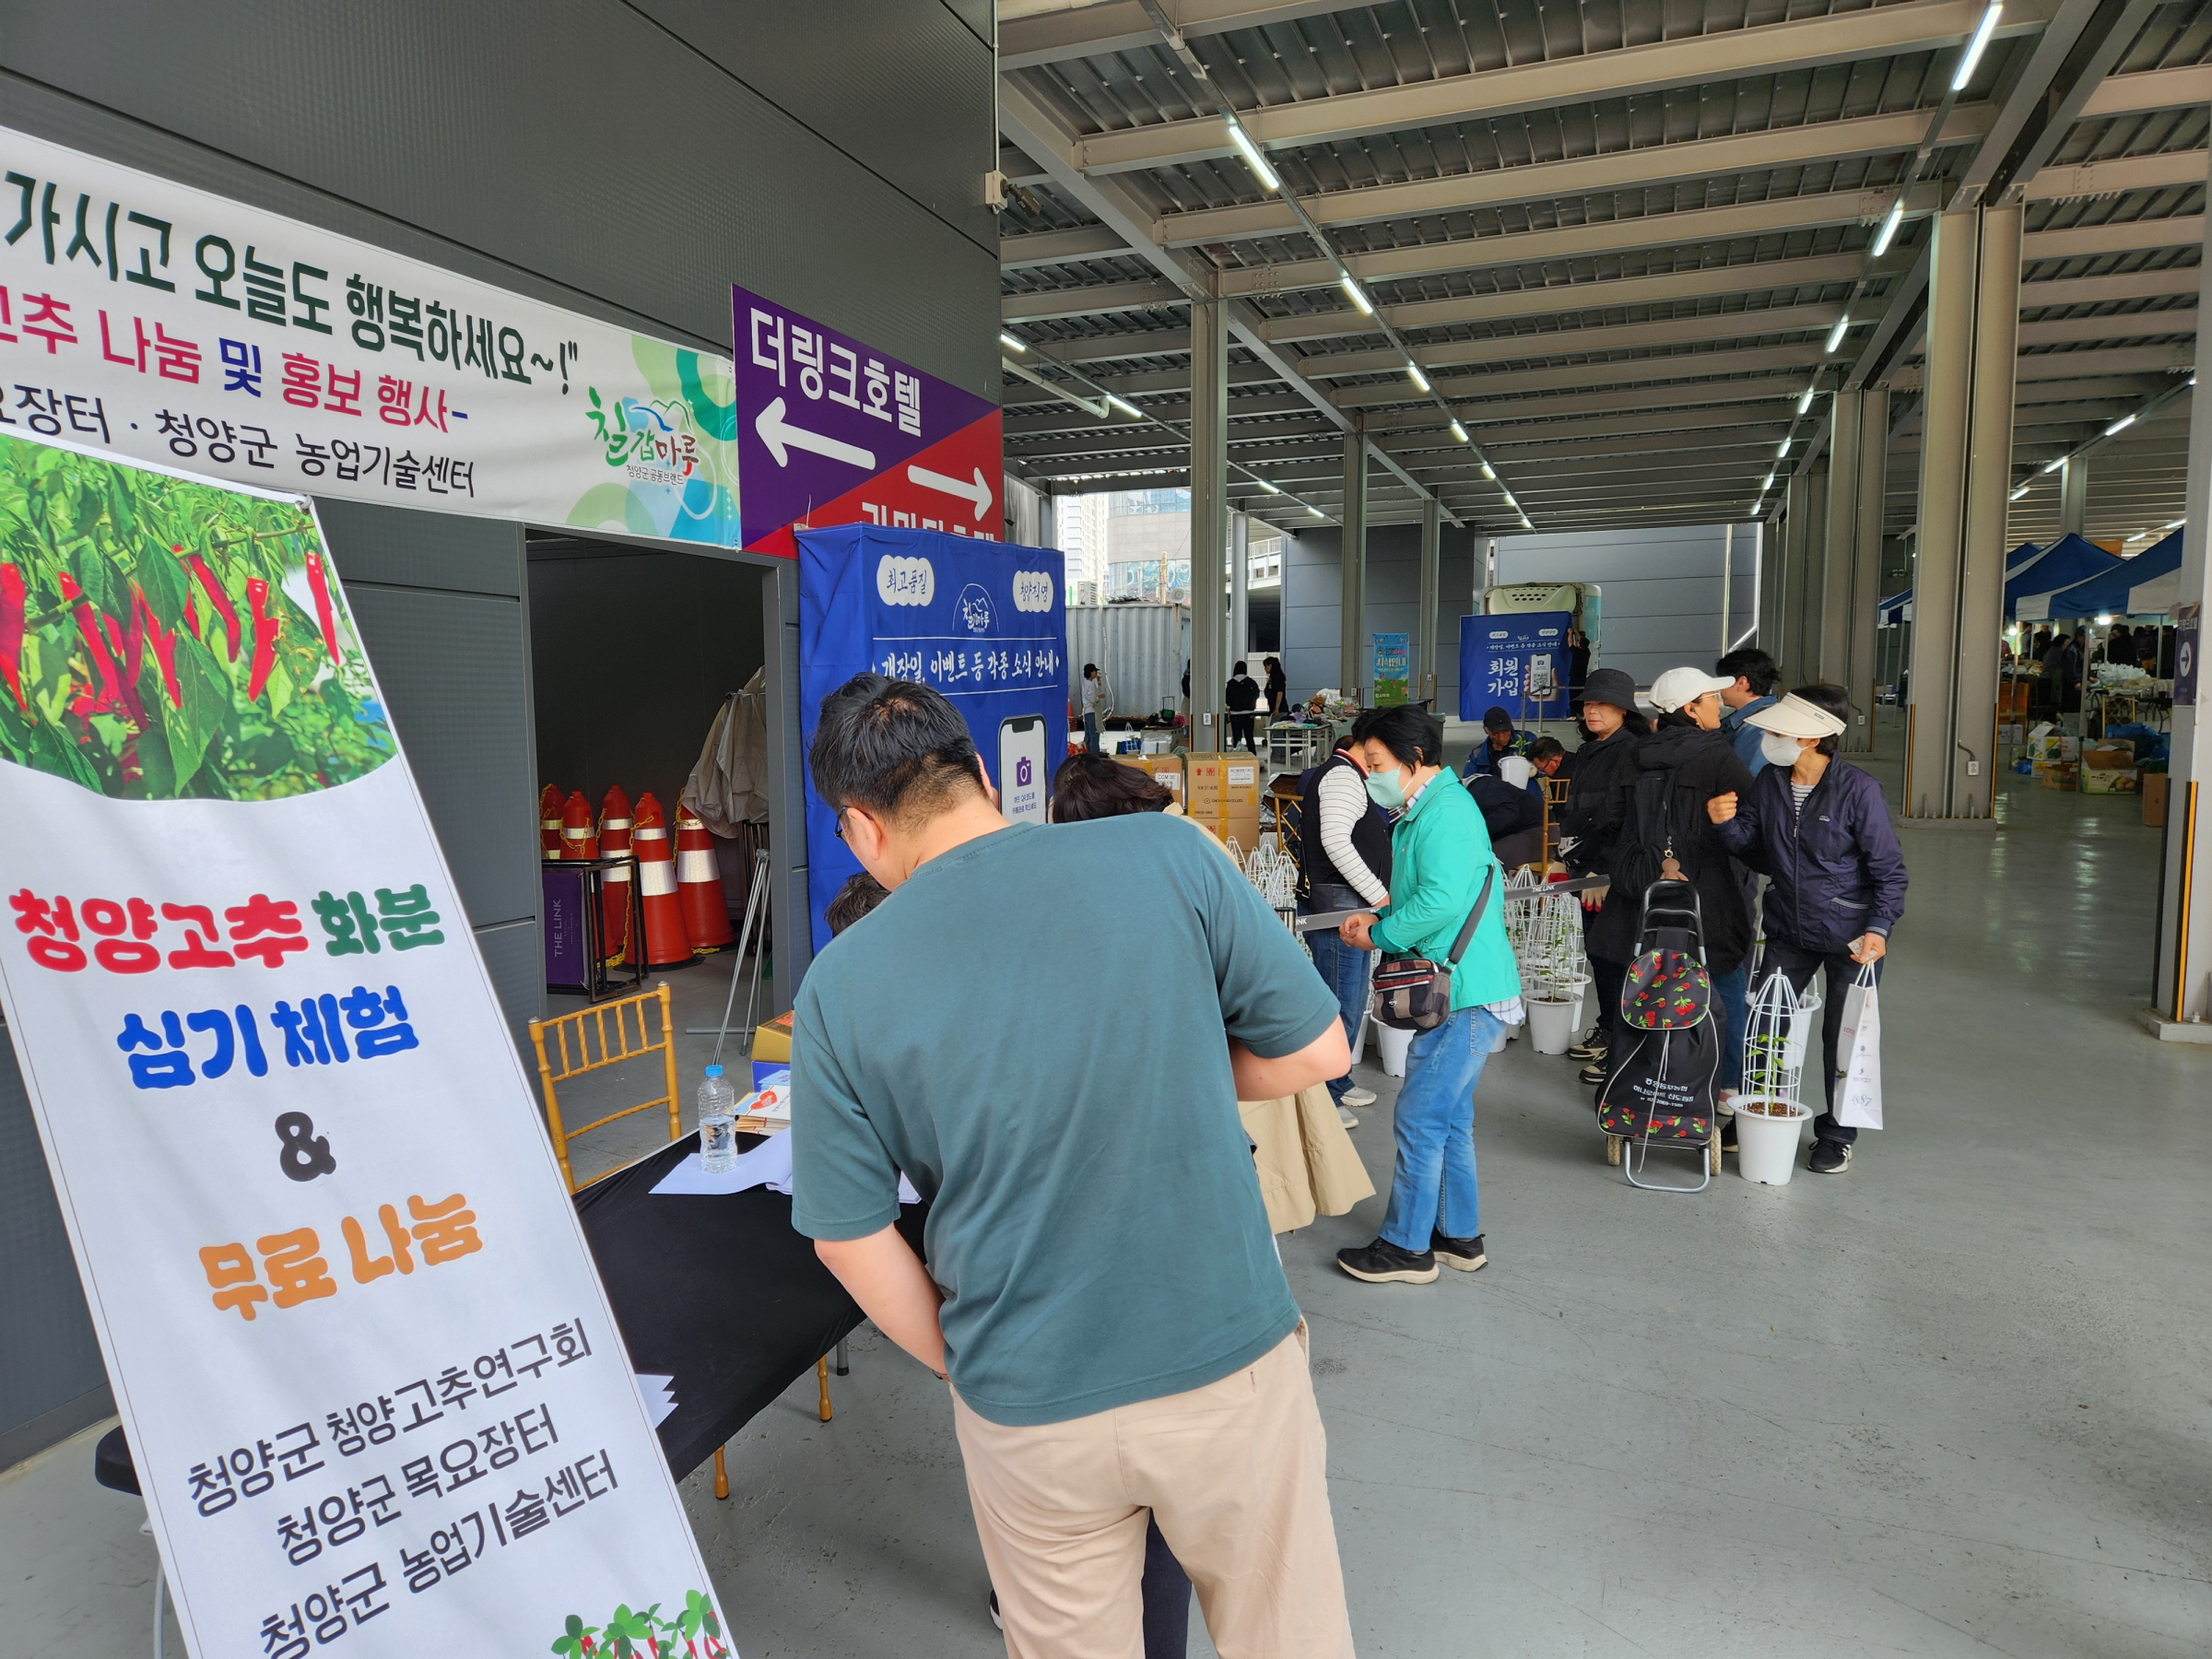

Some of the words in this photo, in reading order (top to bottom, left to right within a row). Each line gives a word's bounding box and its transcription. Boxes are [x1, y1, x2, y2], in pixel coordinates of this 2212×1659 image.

[3, 171, 176, 293] 가시고
[195, 234, 330, 335] 오늘도
[347, 273, 580, 395] 행복하세요~!"
[98, 309, 202, 384] 나눔
[218, 337, 262, 398] 및
[281, 352, 362, 418] 홍보
[378, 374, 468, 434] 행사-
[749, 307, 923, 438] 더링크호텔
[155, 408, 279, 467] 청양군
[295, 432, 476, 499] 농업기술센터
[627, 464, 650, 480] 청양군
[650, 469, 684, 486] 공동브랜드
[887, 568, 927, 595] 최고품질
[1019, 581, 1048, 604] 청양직영
[930, 650, 968, 683] 이벤트
[971, 652, 984, 682] 등
[987, 651, 1009, 680] 각종
[1011, 650, 1031, 678] 소식
[1035, 649, 1054, 678] 안내
[1488, 657, 1519, 677] 회원
[1488, 677, 1519, 697] 가입
[7, 888, 310, 973] 청양고추
[311, 883, 446, 956] 화분
[553, 899, 562, 929] LINK
[554, 932, 563, 958] THE
[116, 1003, 268, 1090] 심기
[270, 985, 419, 1067] 체험
[274, 1112, 337, 1182] &
[198, 1227, 338, 1321] 무료
[340, 1193, 484, 1284] 나눔
[187, 1422, 324, 1518] 청양군
[325, 1317, 594, 1458] 청양고추연구회
[276, 1478, 405, 1567] 청양군
[400, 1404, 559, 1501] 목요장터
[259, 1564, 392, 1659] 청양군
[399, 1450, 619, 1594] 농업기술센터
